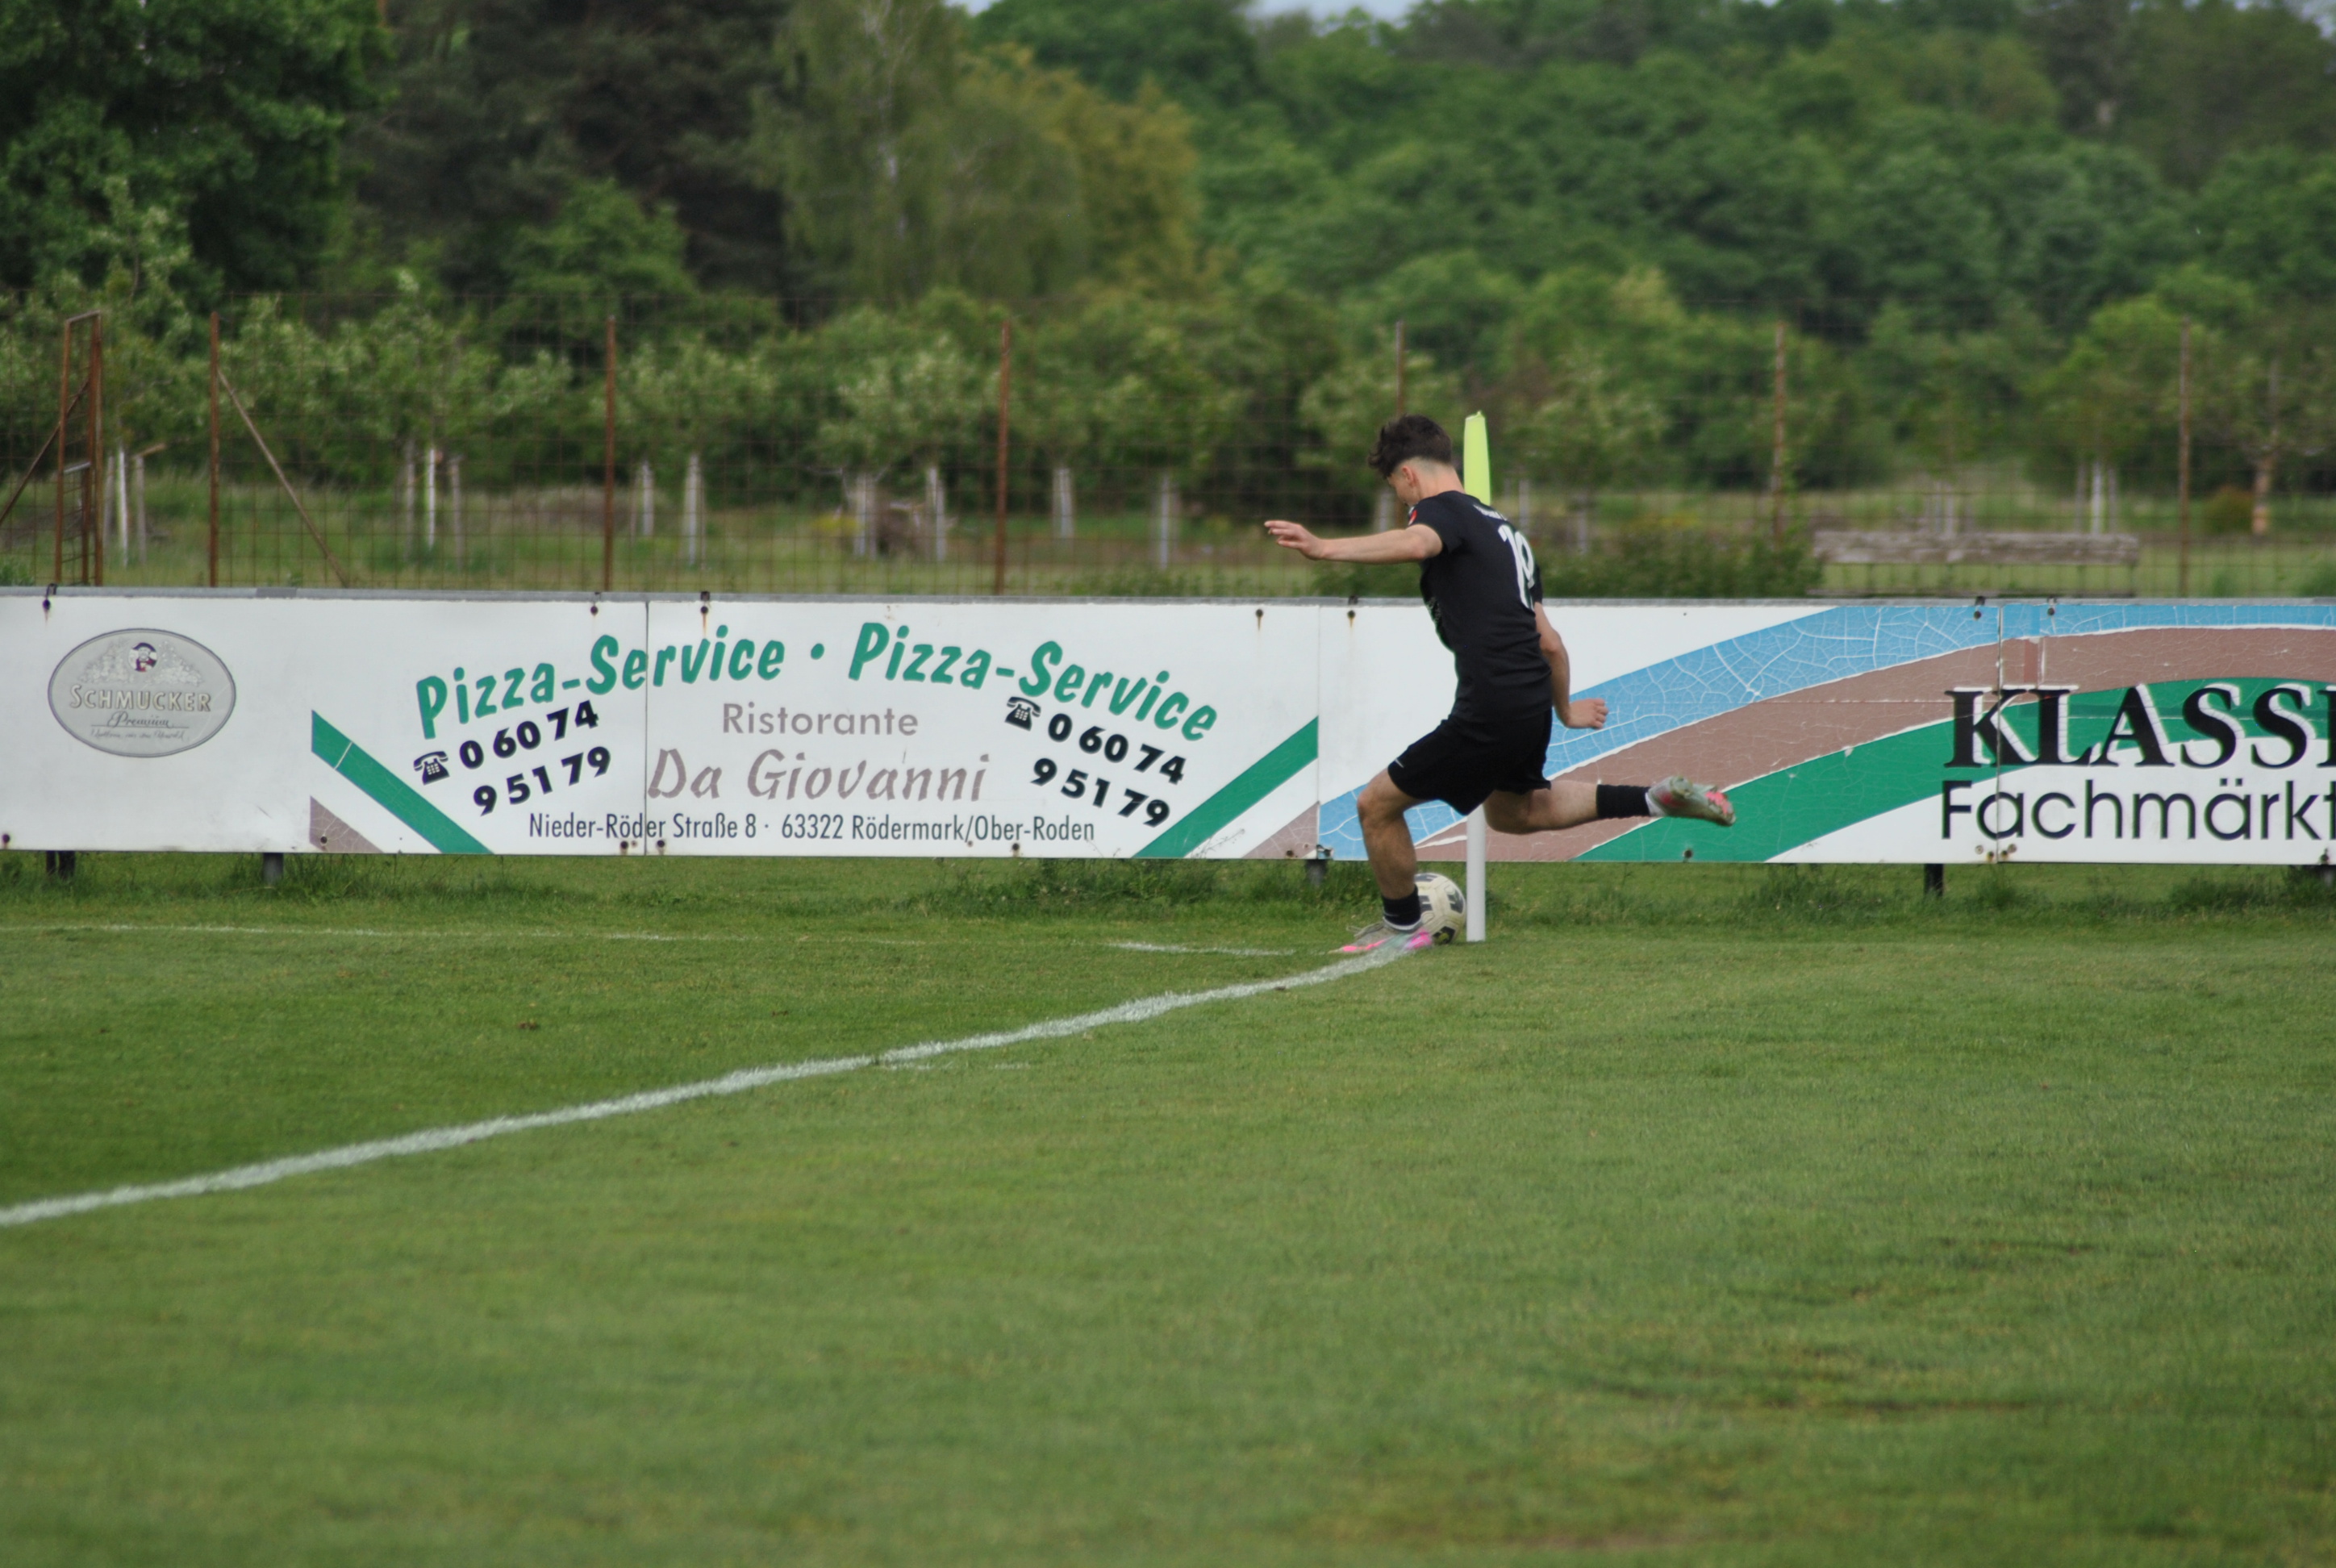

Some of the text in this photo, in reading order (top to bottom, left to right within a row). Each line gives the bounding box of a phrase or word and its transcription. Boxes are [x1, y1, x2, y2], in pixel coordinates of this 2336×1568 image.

[69, 684, 211, 712] SCHMUCKER
[415, 622, 1217, 740] Pizza-Service Pizza-Service
[724, 701, 919, 736] Ristorante
[648, 748, 990, 802] Da Giovanni
[529, 812, 1095, 842] Nieder-Röder Straße 8 63322 Rödermark/Ober-Roden
